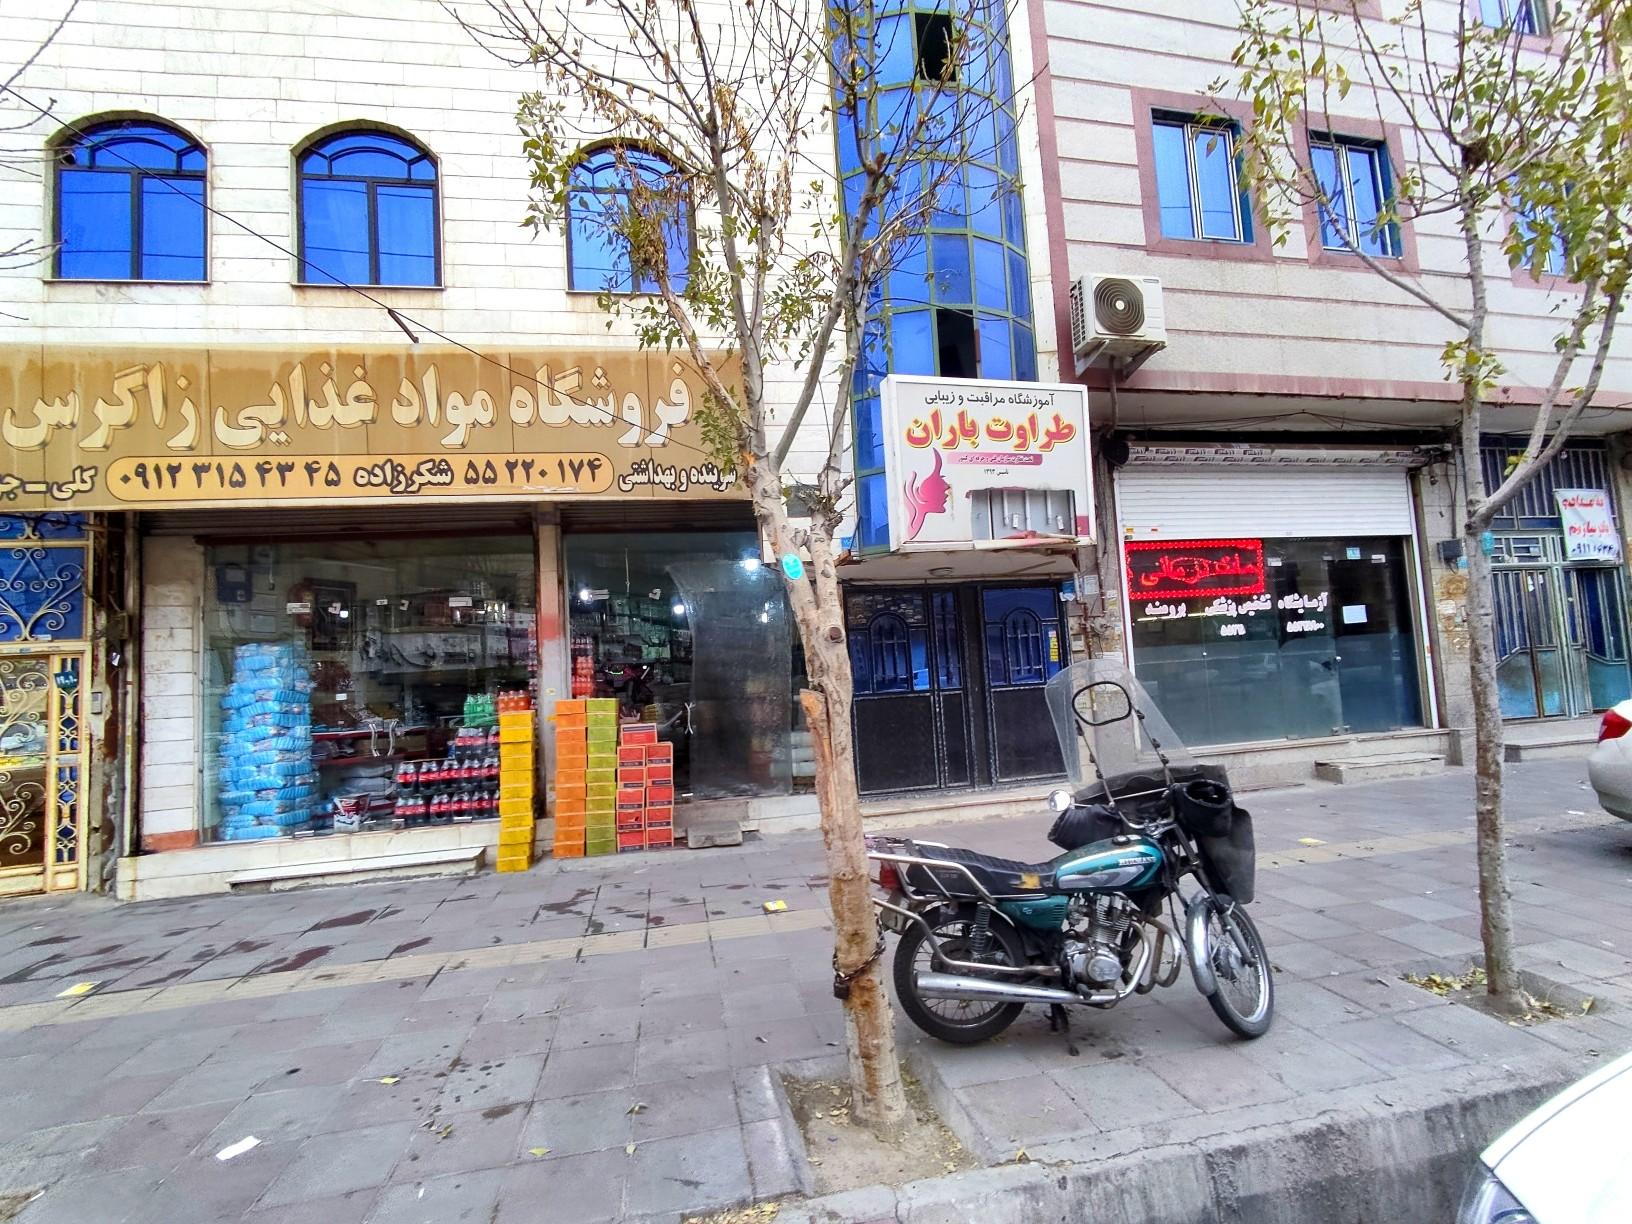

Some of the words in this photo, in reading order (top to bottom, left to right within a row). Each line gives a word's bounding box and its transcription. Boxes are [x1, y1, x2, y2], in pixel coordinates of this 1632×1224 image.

[2, 361, 200, 451] زاگرس
[213, 360, 380, 450] غذایی
[391, 362, 498, 450] مواد
[509, 361, 694, 449] فروشگاه
[924, 389, 955, 406] زیبایی
[958, 395, 964, 405] و
[966, 391, 1006, 407] مراقبت
[1008, 393, 1055, 410] آموزشگاه
[905, 407, 980, 450] باران
[984, 411, 1077, 453] طراوت
[353, 458, 454, 494] شکرزاده
[618, 459, 676, 492] بهداشتی
[678, 469, 688, 492] و
[1204, 596, 1238, 618] پزشکی
[1238, 593, 1272, 617] تشخیص
[1277, 592, 1329, 614] آزمایشگاه
